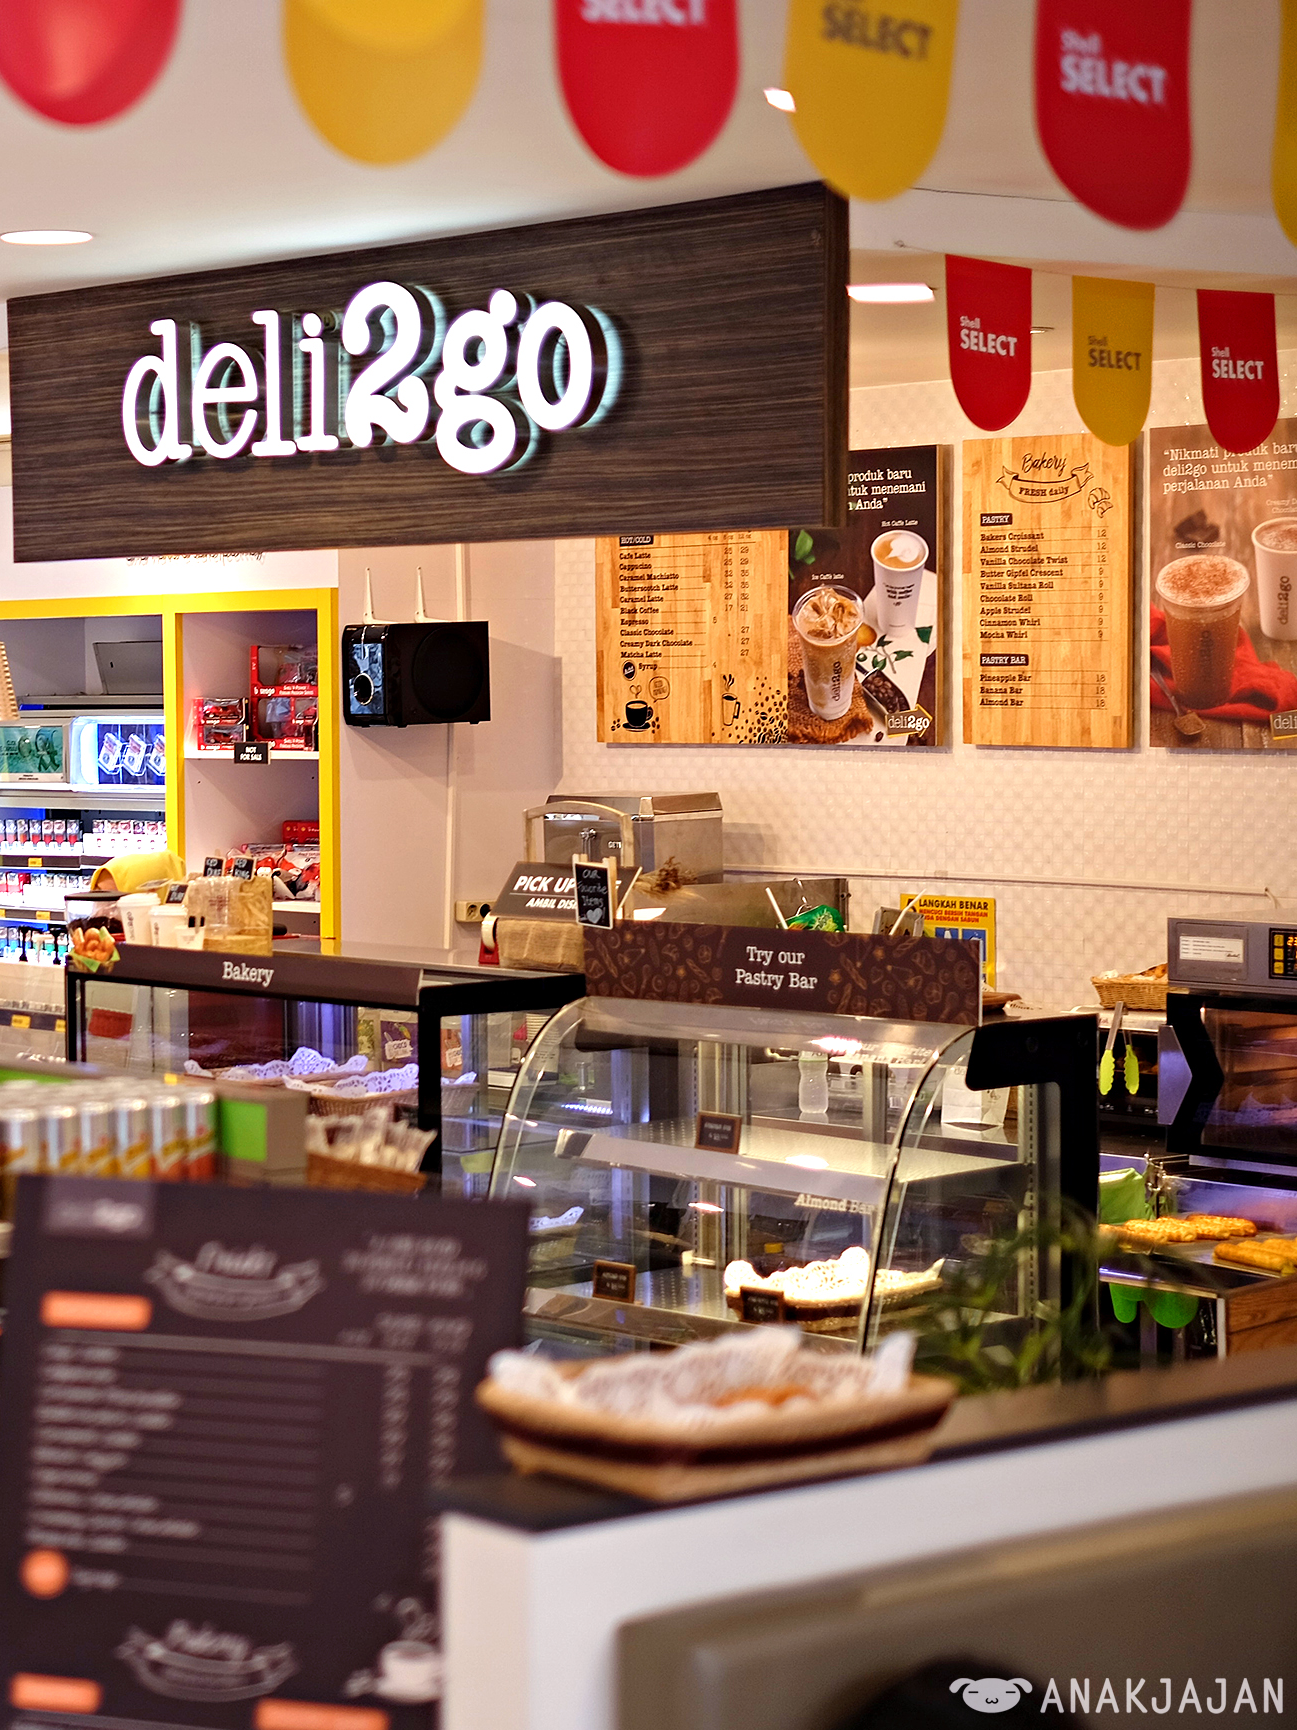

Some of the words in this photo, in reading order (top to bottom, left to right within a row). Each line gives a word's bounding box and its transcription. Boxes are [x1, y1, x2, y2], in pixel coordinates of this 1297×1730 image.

[1062, 54, 1166, 104] SELECT
[960, 315, 980, 329] Shell
[960, 329, 1017, 356] SELECT
[1088, 336, 1107, 346] Shell
[1088, 349, 1141, 371] SELECT
[1211, 347, 1229, 358] Shell
[1212, 359, 1264, 380] SELECT
[122, 281, 594, 475] deli2go
[1022, 452, 1067, 477] Bakery
[1163, 464, 1207, 477] deli2go
[1211, 461, 1249, 473] untuk
[848, 469, 884, 484] produk
[887, 469, 912, 480] baru
[871, 482, 926, 495] menemani
[1019, 487, 1047, 496] FRESH
[1049, 486, 1069, 496] daily
[1163, 479, 1229, 494] perjalanan
[982, 515, 1010, 524] PASTRY
[1097, 542, 1106, 550] 12
[1006, 570, 1028, 578] Gipfel
[1277, 576, 1291, 625] deli2go
[980, 607, 1001, 615] Apple
[888, 715, 929, 731] deli2go
[513, 876, 553, 892] PICK
[554, 878, 576, 893] UP
[526, 898, 556, 908] AMBIL
[919, 899, 956, 908] LANGKAH
[959, 901, 988, 910] BENAR
[746, 946, 773, 965] Try
[778, 951, 805, 964] our
[222, 961, 274, 988] Bakery
[735, 968, 784, 990] Pastry
[789, 973, 818, 989] Bar
[794, 1194, 847, 1212] Almond
